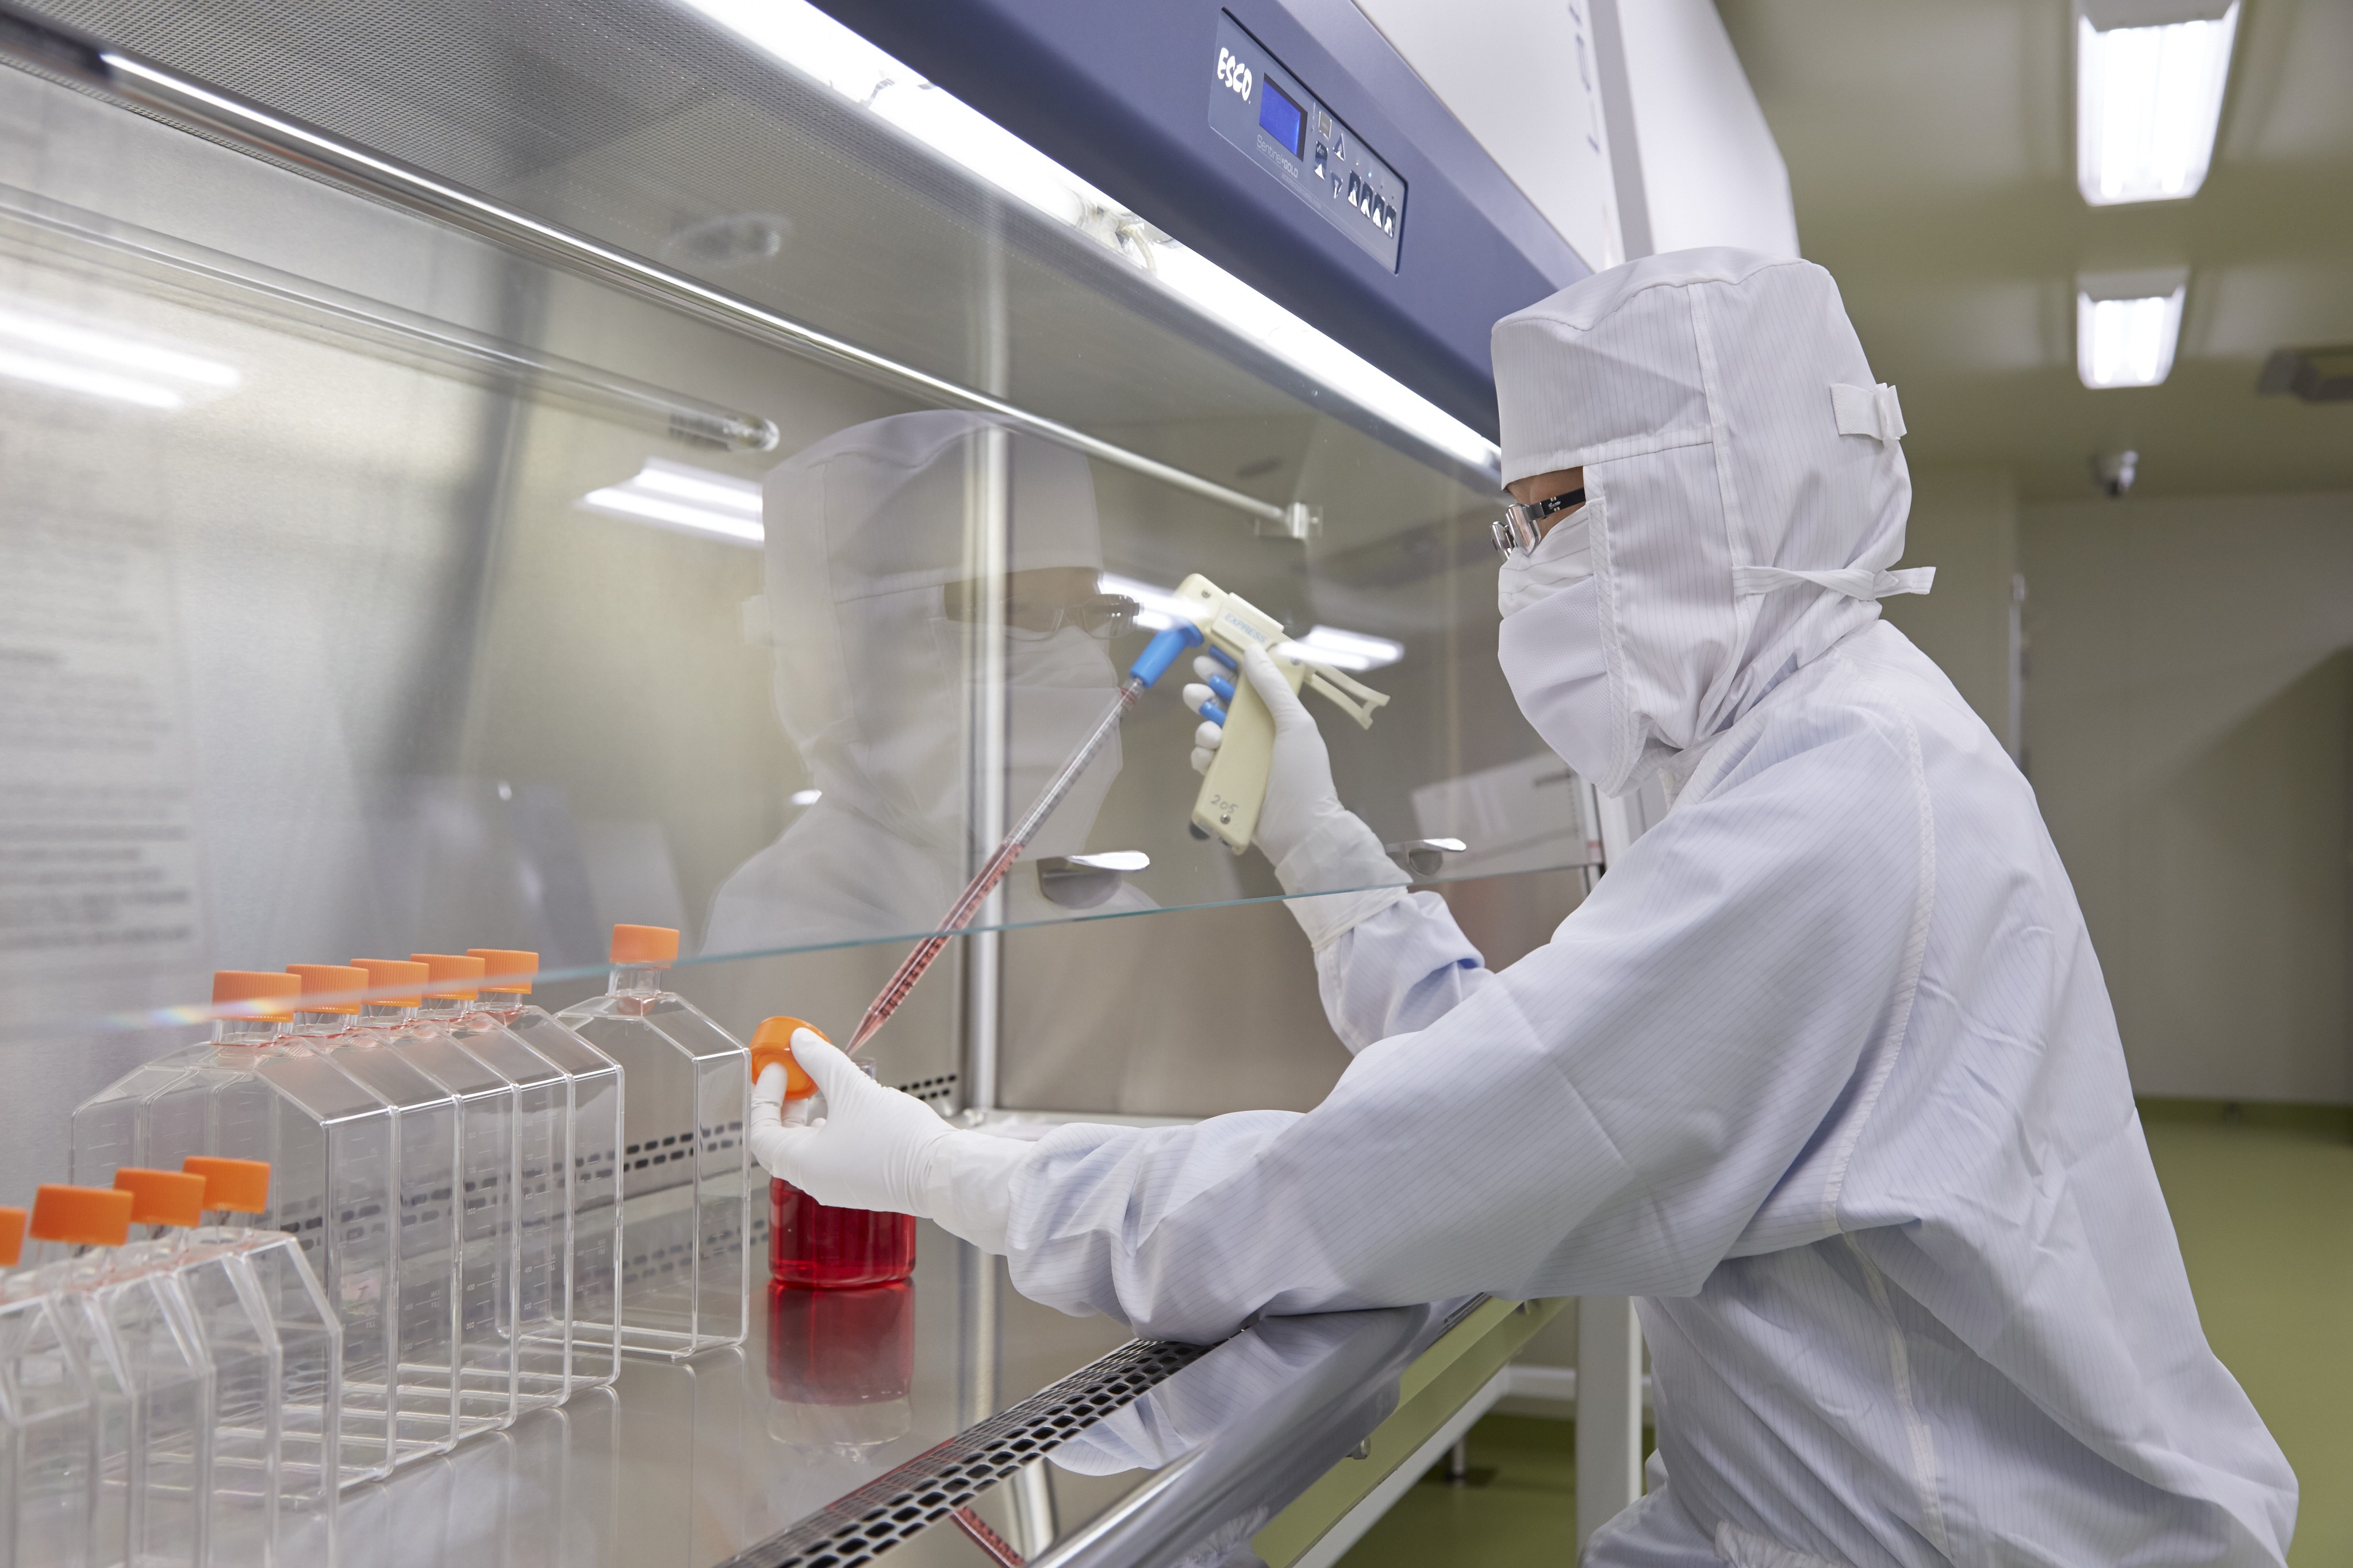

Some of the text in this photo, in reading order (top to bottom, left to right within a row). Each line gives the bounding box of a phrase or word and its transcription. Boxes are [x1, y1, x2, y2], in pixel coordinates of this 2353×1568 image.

[1217, 47, 1252, 101] ESCO
[1225, 613, 1268, 643] EXPRESS
[1211, 794, 1238, 814] 205
